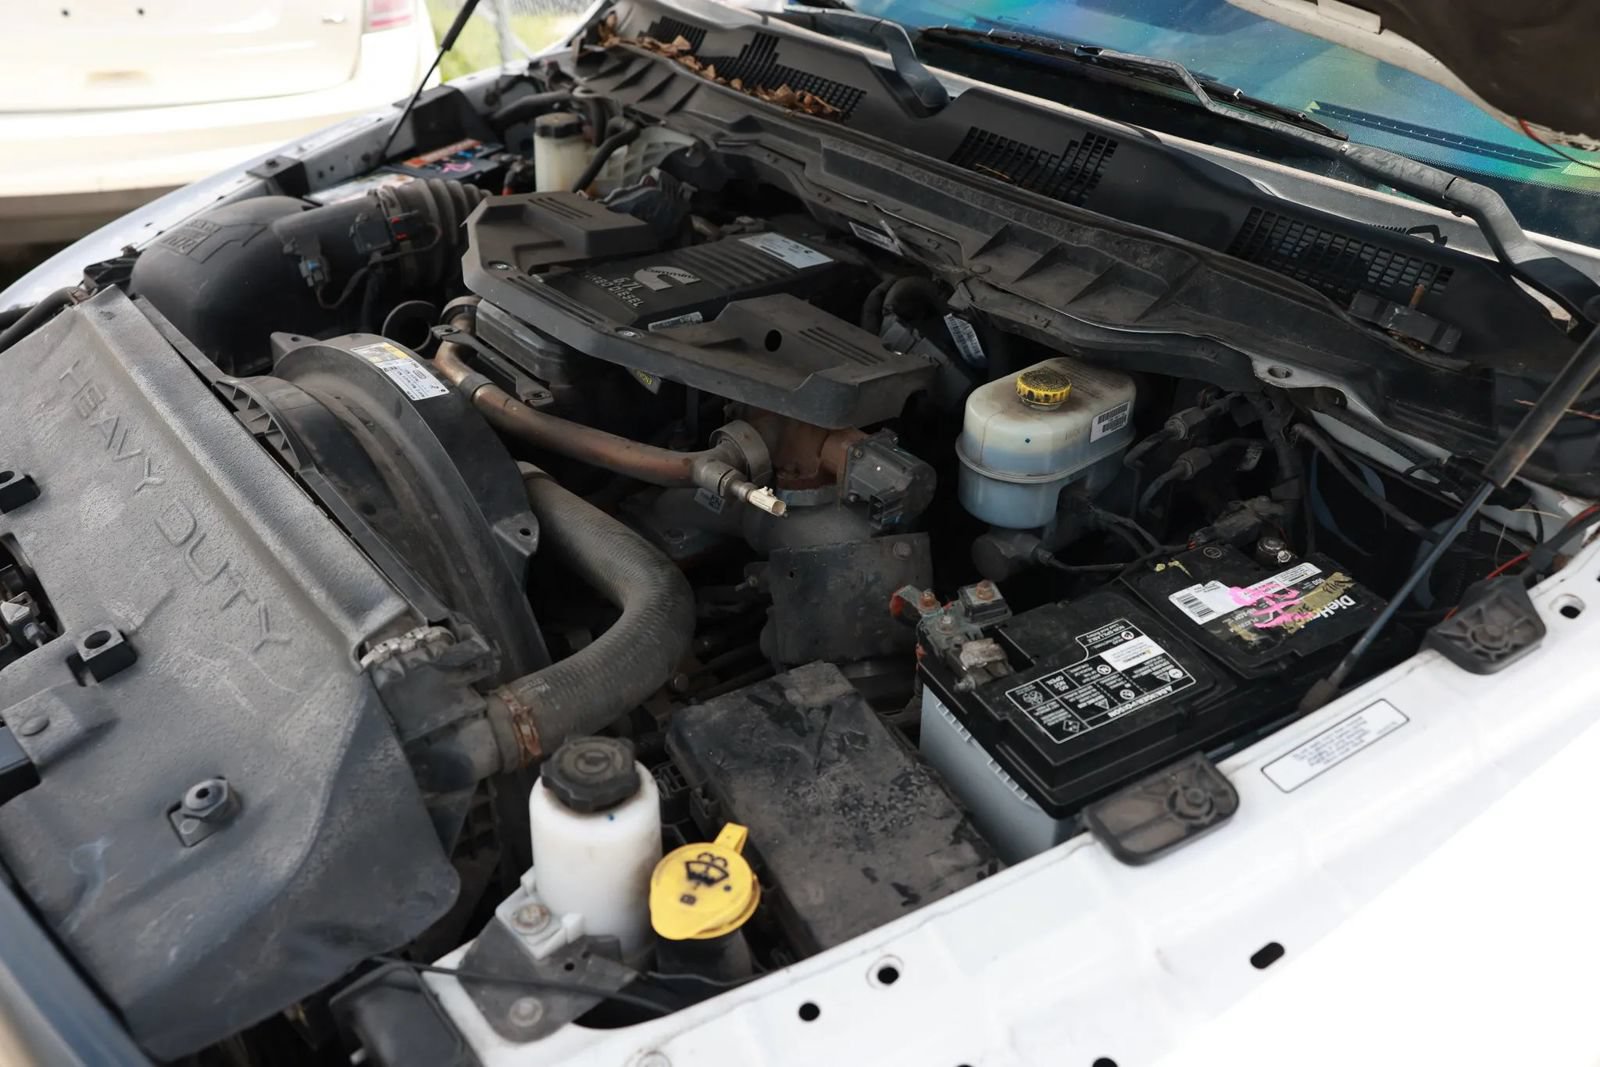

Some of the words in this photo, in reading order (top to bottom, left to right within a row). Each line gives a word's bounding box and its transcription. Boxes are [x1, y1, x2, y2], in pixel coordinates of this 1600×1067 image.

[607, 285, 644, 307] DIESEL
[58, 360, 166, 496] HEAVY
[153, 500, 292, 653] DUTY
